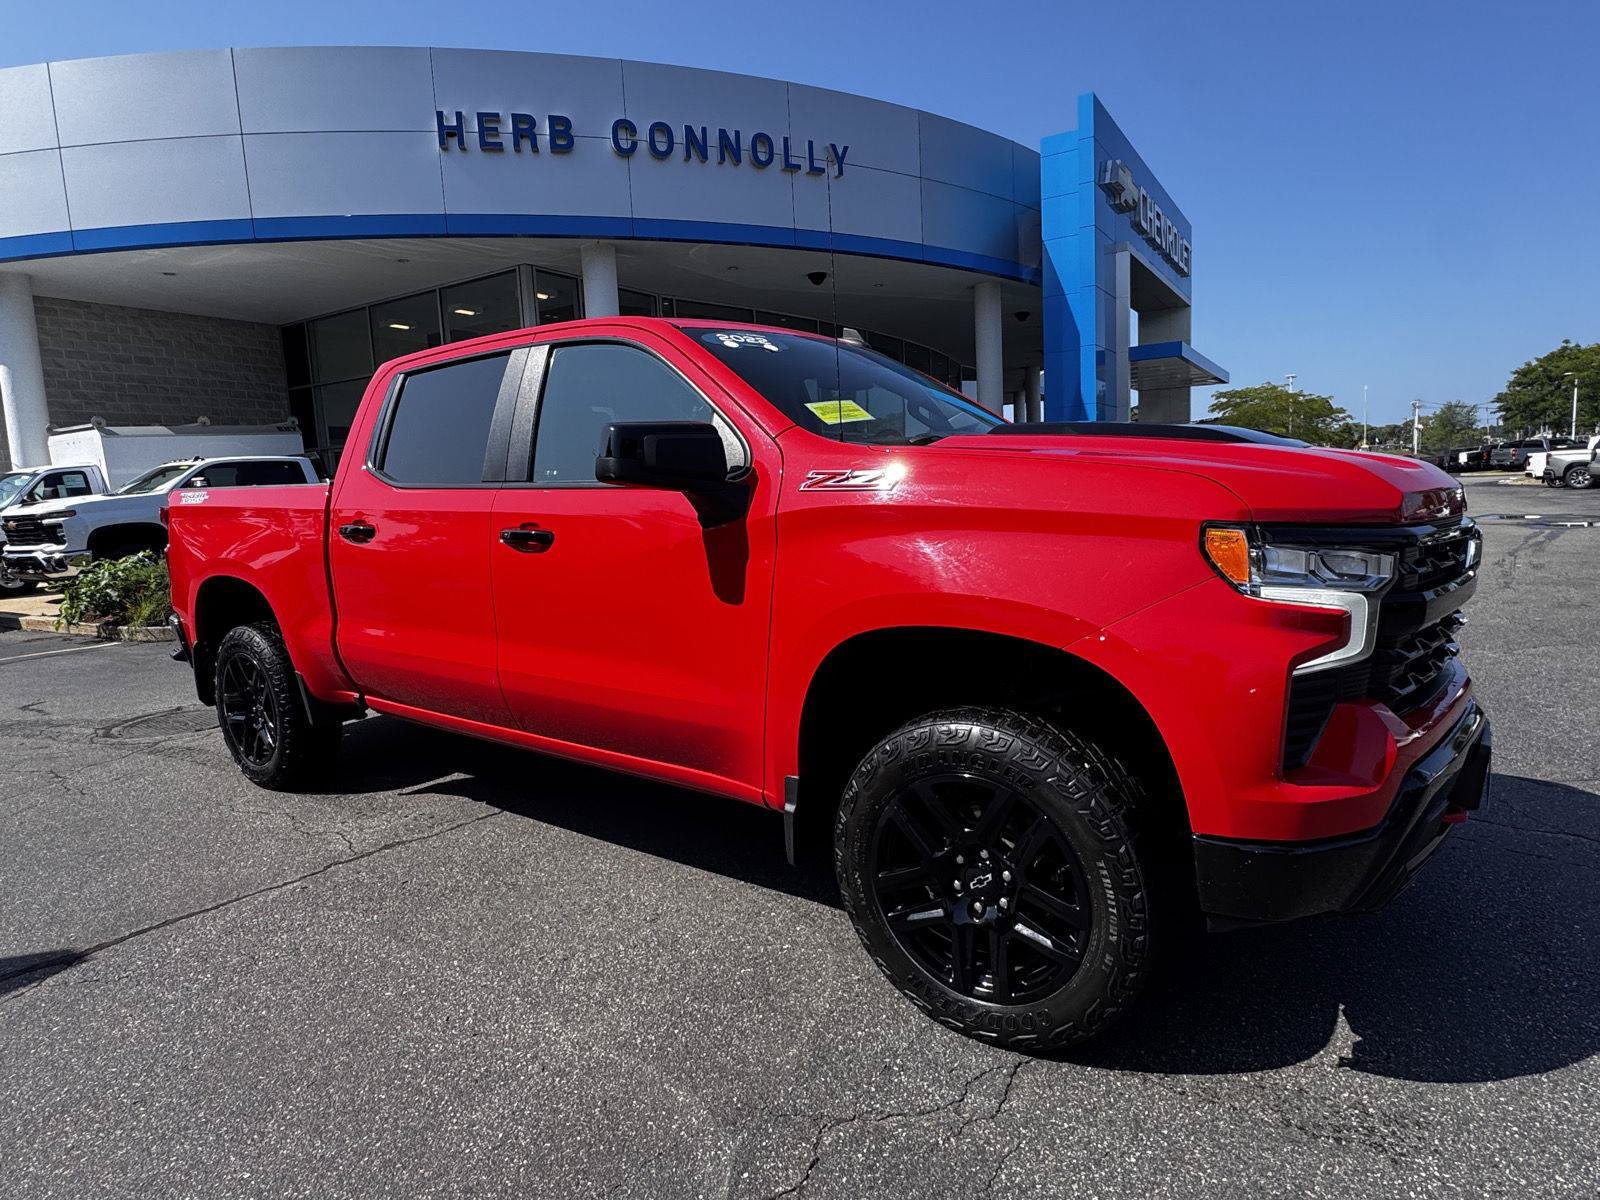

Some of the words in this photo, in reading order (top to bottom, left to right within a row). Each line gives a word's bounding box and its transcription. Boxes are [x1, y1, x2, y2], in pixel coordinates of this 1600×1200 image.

[435, 110, 575, 154] HERB
[610, 118, 849, 178] CONNOLLY
[1138, 185, 1191, 276] CHEVROLET
[798, 468, 901, 492] Z7
